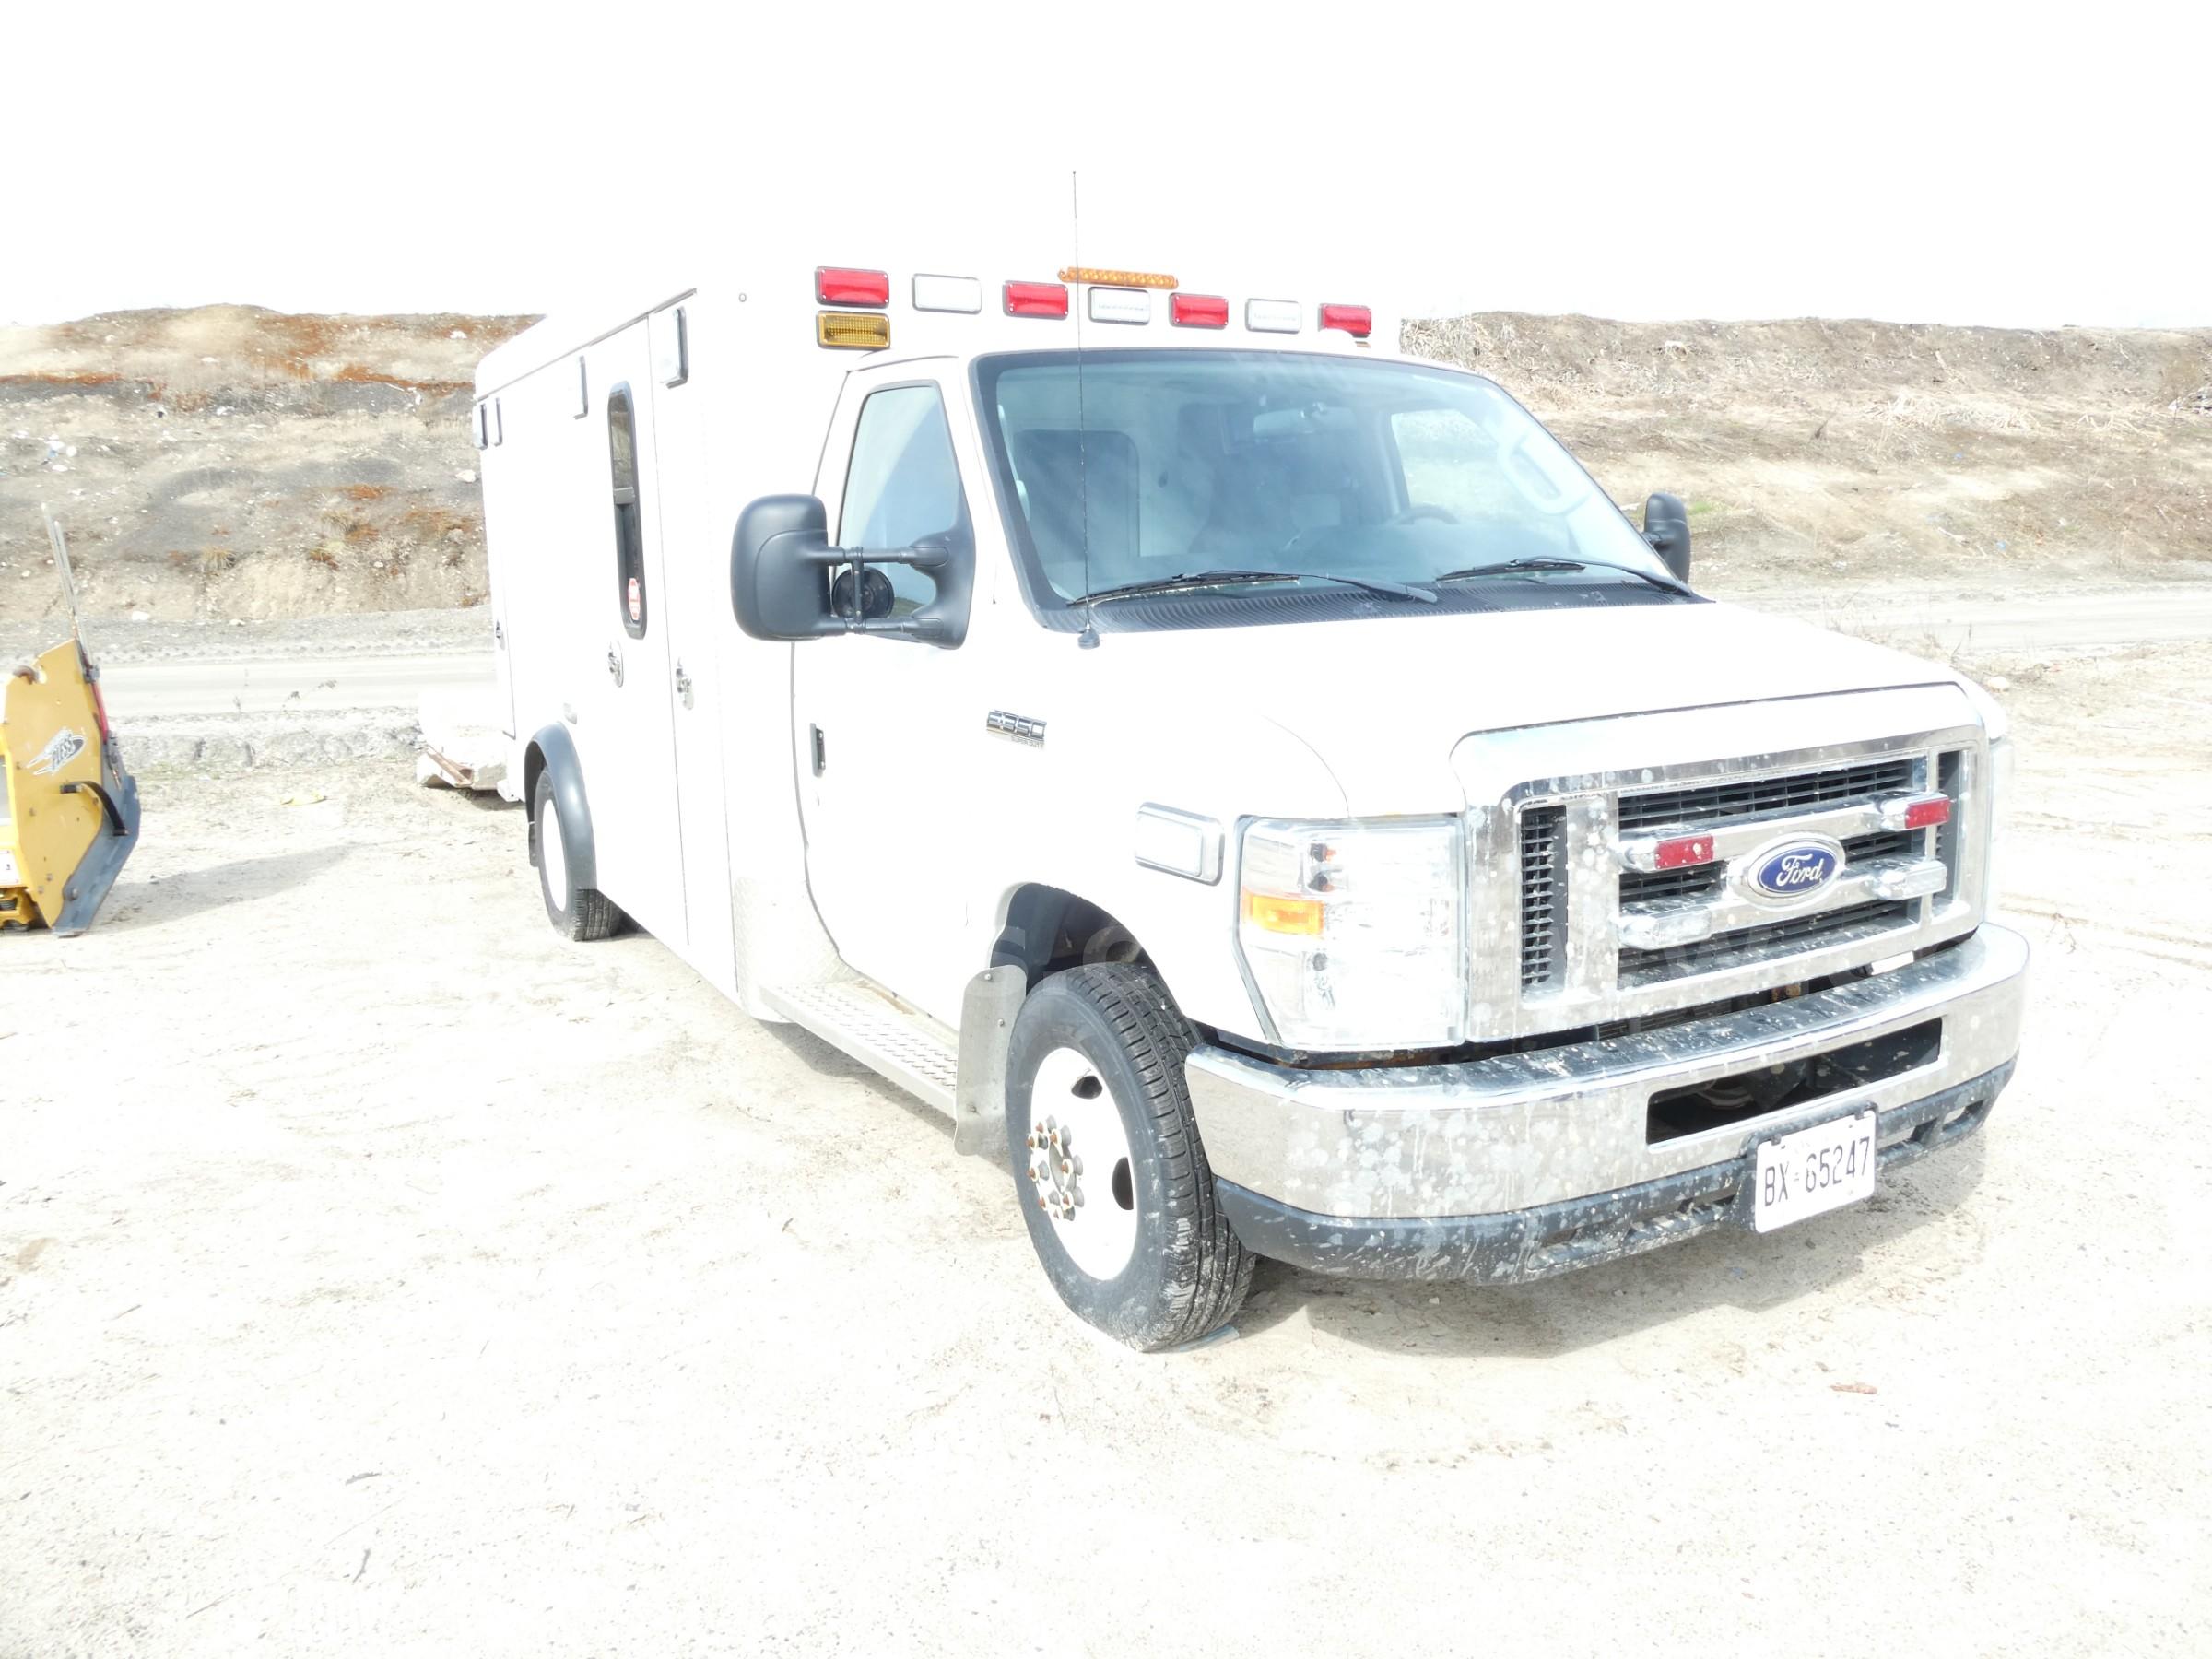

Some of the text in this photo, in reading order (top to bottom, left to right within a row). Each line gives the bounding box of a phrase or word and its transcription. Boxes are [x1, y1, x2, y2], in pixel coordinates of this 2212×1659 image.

[1776, 853, 1825, 887] Ford
[1764, 1160, 1790, 1207] BX
[1806, 1135, 1871, 1193] 65247
